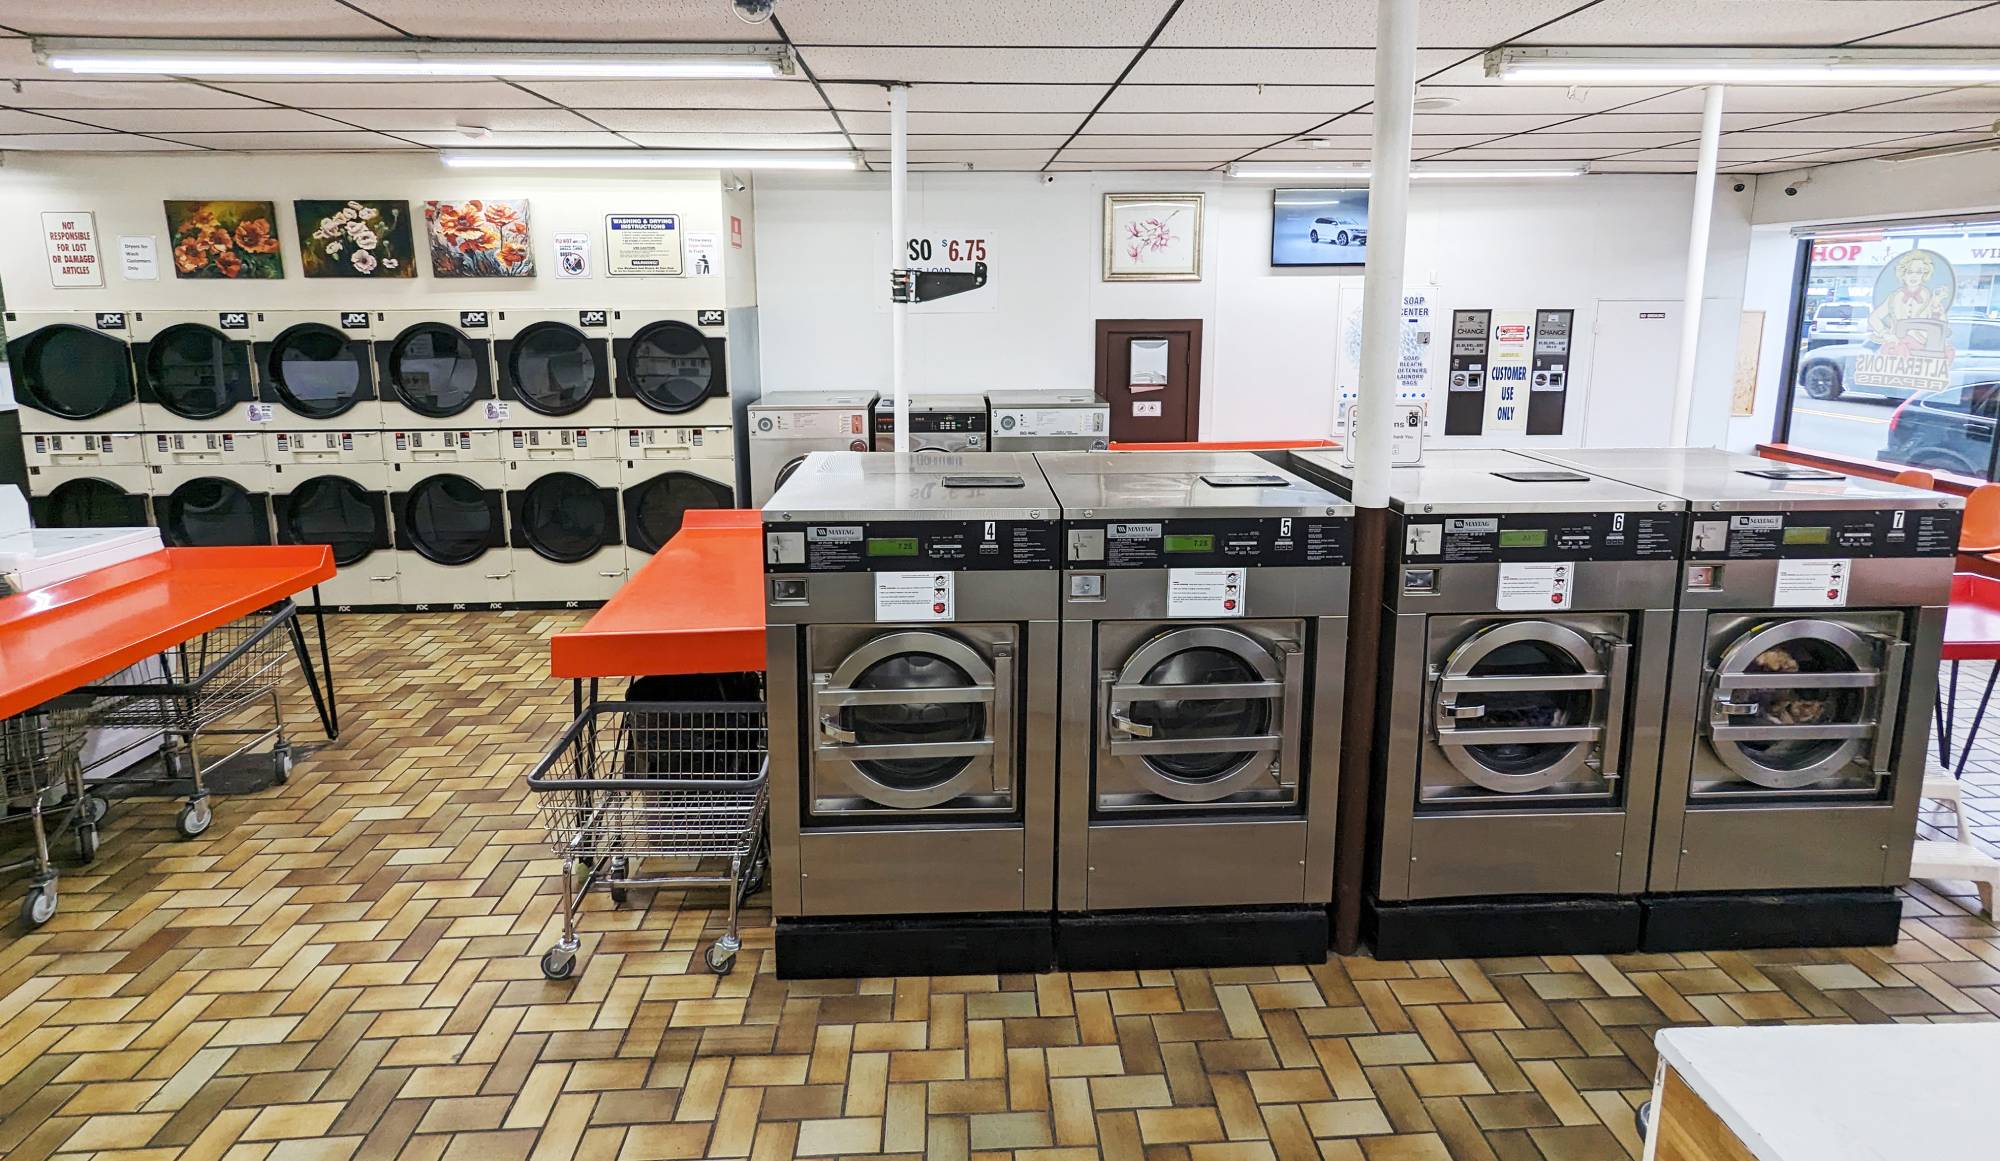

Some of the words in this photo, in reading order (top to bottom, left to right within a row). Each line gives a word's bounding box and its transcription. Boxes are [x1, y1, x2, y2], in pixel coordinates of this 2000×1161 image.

[50, 231, 90, 240] RESPONSIBLE
[907, 239, 932, 261] SO
[53, 255, 63, 263] OR
[64, 255, 95, 263] DAMAGED
[62, 267, 90, 275] ARTICLES
[1403, 297, 1424, 305] SOAP
[103, 313, 121, 324] ADC
[227, 313, 245, 323] ADC
[348, 313, 366, 323] ADC
[467, 312, 485, 322] ADC
[586, 311, 604, 321] ADC
[704, 310, 722, 321] ADC
[1491, 366, 1527, 381] CUSTOMER
[1501, 387, 1514, 400] USE
[1497, 407, 1515, 421] ONLY
[1614, 514, 1623, 530] 6
[1750, 517, 1774, 525] MAYTAG
[1895, 512, 1904, 527] 7
[828, 528, 854, 536] MAYTAG
[986, 523, 995, 539] 4
[1128, 525, 1153, 533] MAYTAG
[1282, 519, 1291, 535] 5
